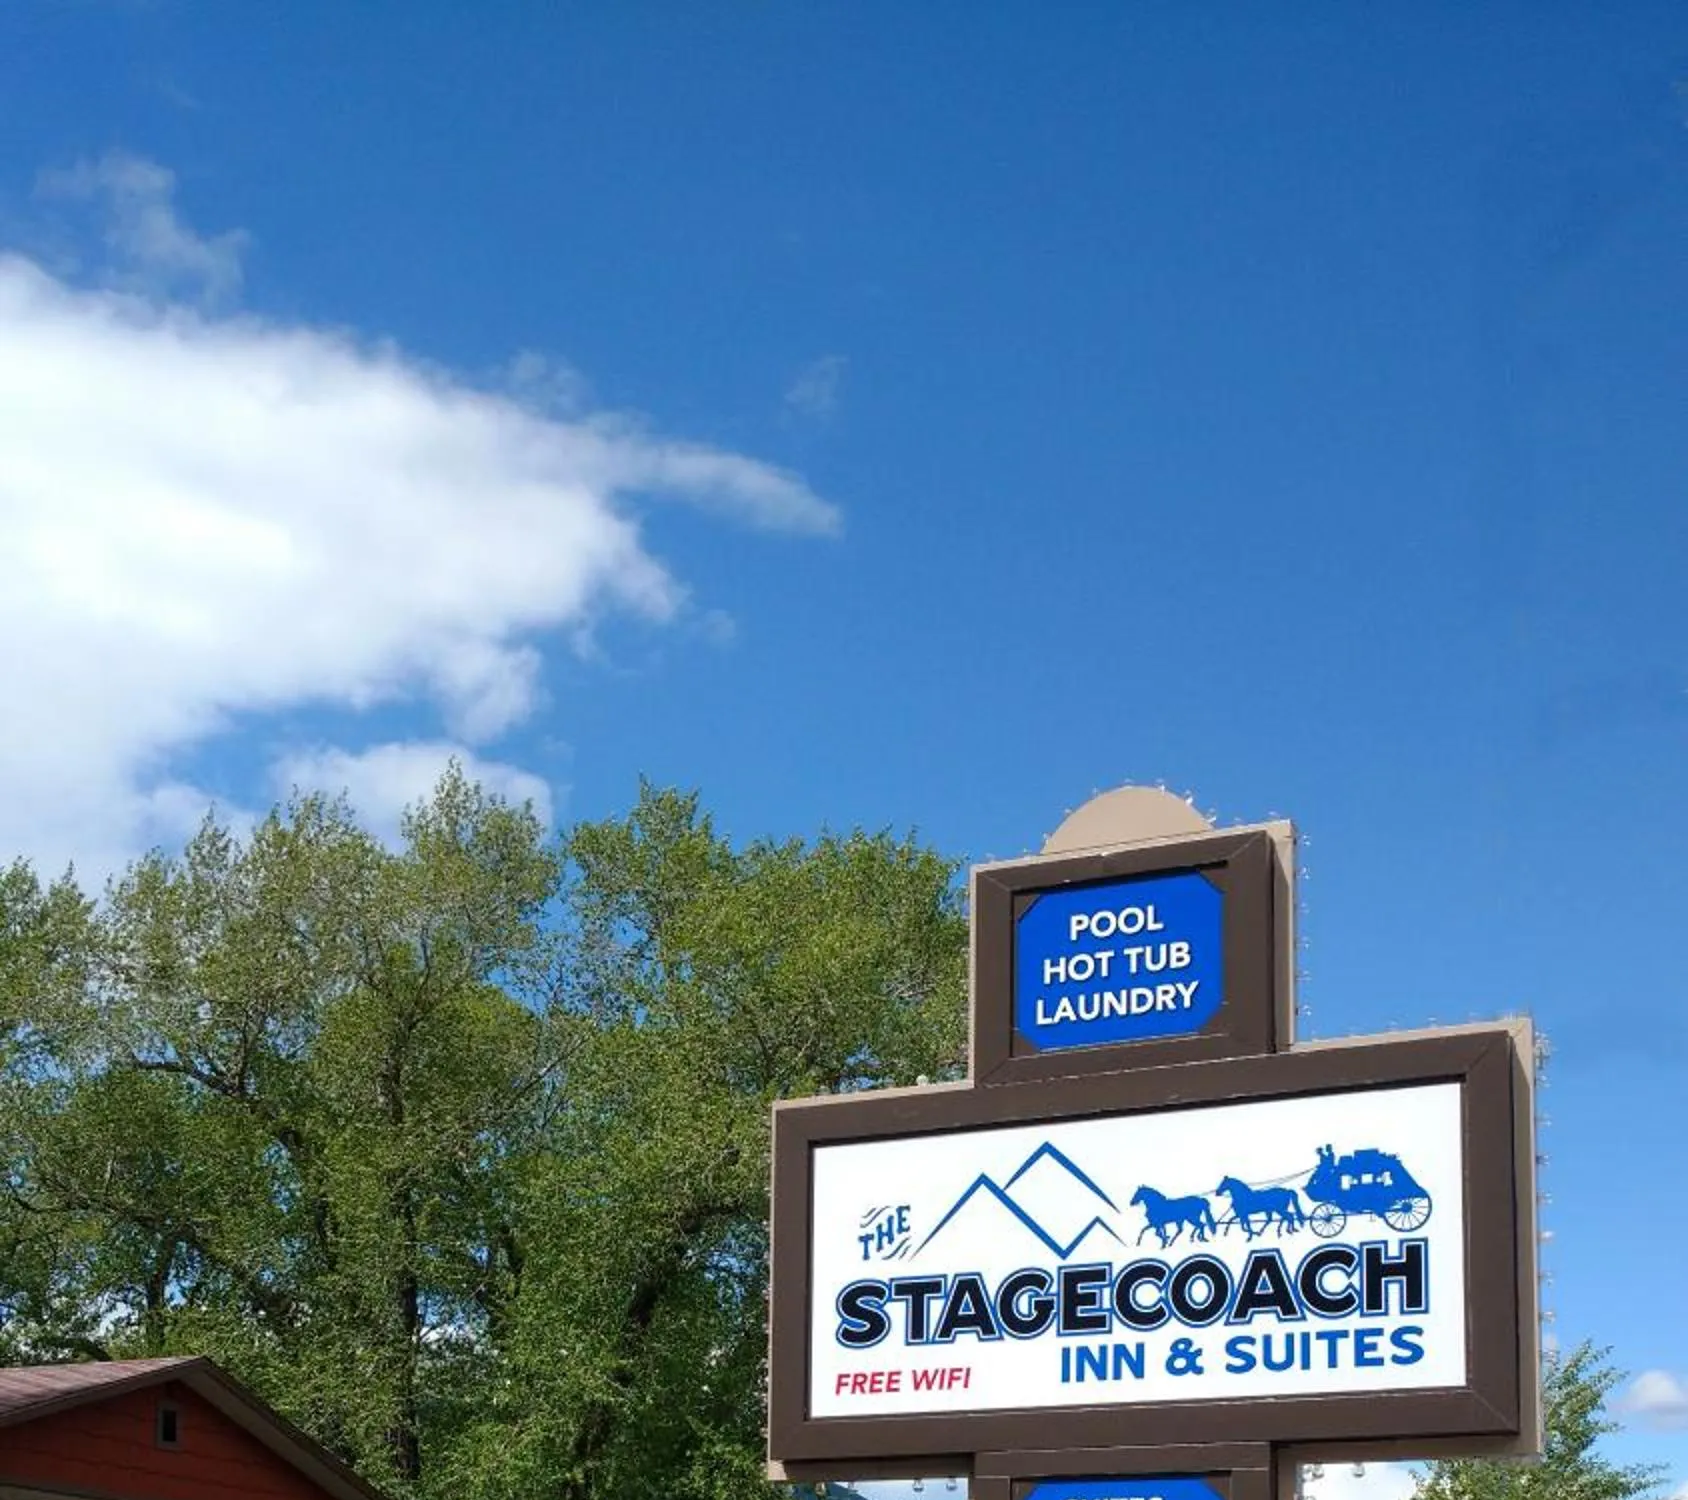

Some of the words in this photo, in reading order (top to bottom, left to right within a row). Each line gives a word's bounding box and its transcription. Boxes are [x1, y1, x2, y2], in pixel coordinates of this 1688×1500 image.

[1070, 905, 1164, 941] POOL
[1043, 950, 1115, 985] HOT
[1123, 941, 1191, 974] TUB
[1035, 980, 1200, 1026] LAUNDRY
[858, 1204, 912, 1262] THE
[834, 1237, 1430, 1350] STAGECOACH
[1060, 1343, 1146, 1383] INN
[1165, 1337, 1205, 1377] &
[1225, 1325, 1426, 1375] SUITES
[834, 1369, 902, 1396] FREE
[911, 1366, 972, 1393] WIFI
